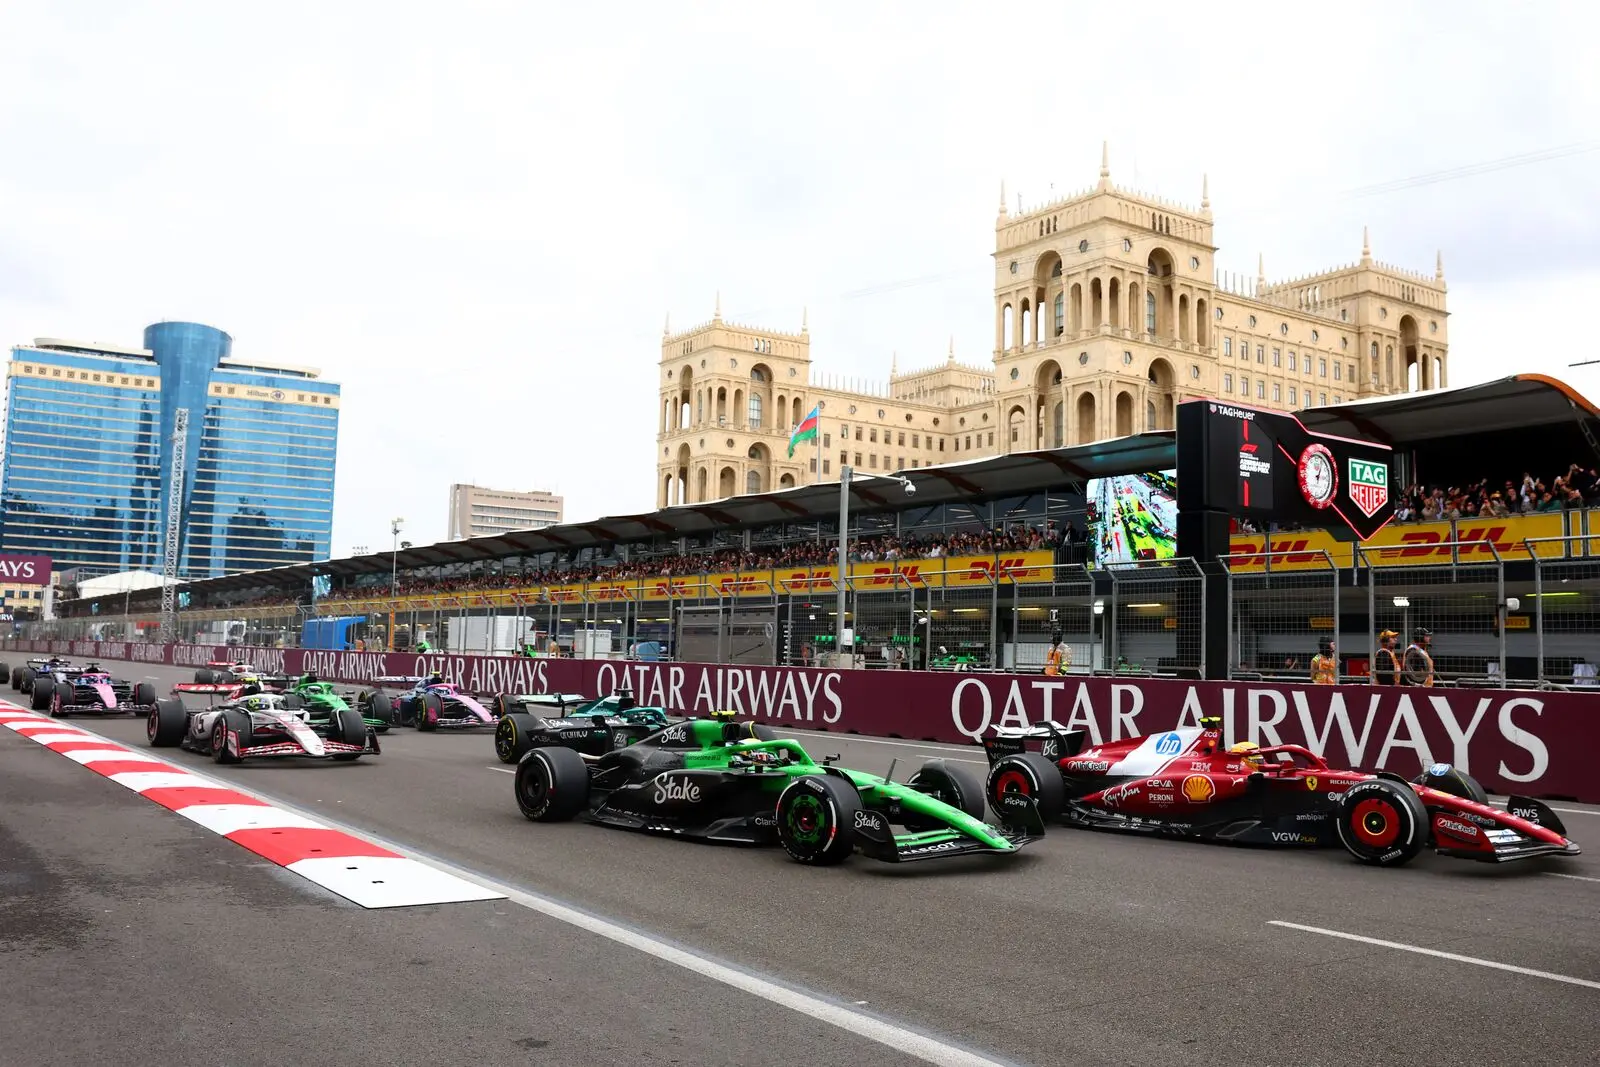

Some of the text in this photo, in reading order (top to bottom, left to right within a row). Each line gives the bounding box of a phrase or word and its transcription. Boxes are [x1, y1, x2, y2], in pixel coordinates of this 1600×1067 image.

[1352, 463, 1385, 484] TAG
[1352, 484, 1386, 513] HEUER
[1401, 527, 1506, 558] DHL
[1230, 540, 1311, 567] DHL
[873, 566, 922, 585] DHL
[969, 558, 1028, 580] DHL
[720, 577, 757, 593] DHL
[791, 571, 832, 590] DHL
[303, 651, 387, 681] QATAR AIRWAYS
[415, 656, 548, 695] QATAR AIRWAYS
[597, 663, 842, 724] QATAR AIRWAYS
[661, 726, 687, 743] Stake
[951, 678, 1550, 783] QATAR AIRWAYS
[1158, 733, 1180, 755] hp
[1076, 761, 1109, 771] UniCredit
[1190, 761, 1212, 773] IBM
[654, 771, 702, 804] Stake
[1148, 793, 1174, 801] PERONI
[1004, 797, 1028, 808] PicPay
[1512, 806, 1539, 818] aws
[854, 811, 881, 831] Stake
[1296, 813, 1325, 822] ambipar
[1271, 831, 1300, 842] VGW
[1444, 819, 1477, 836] UniCredit
